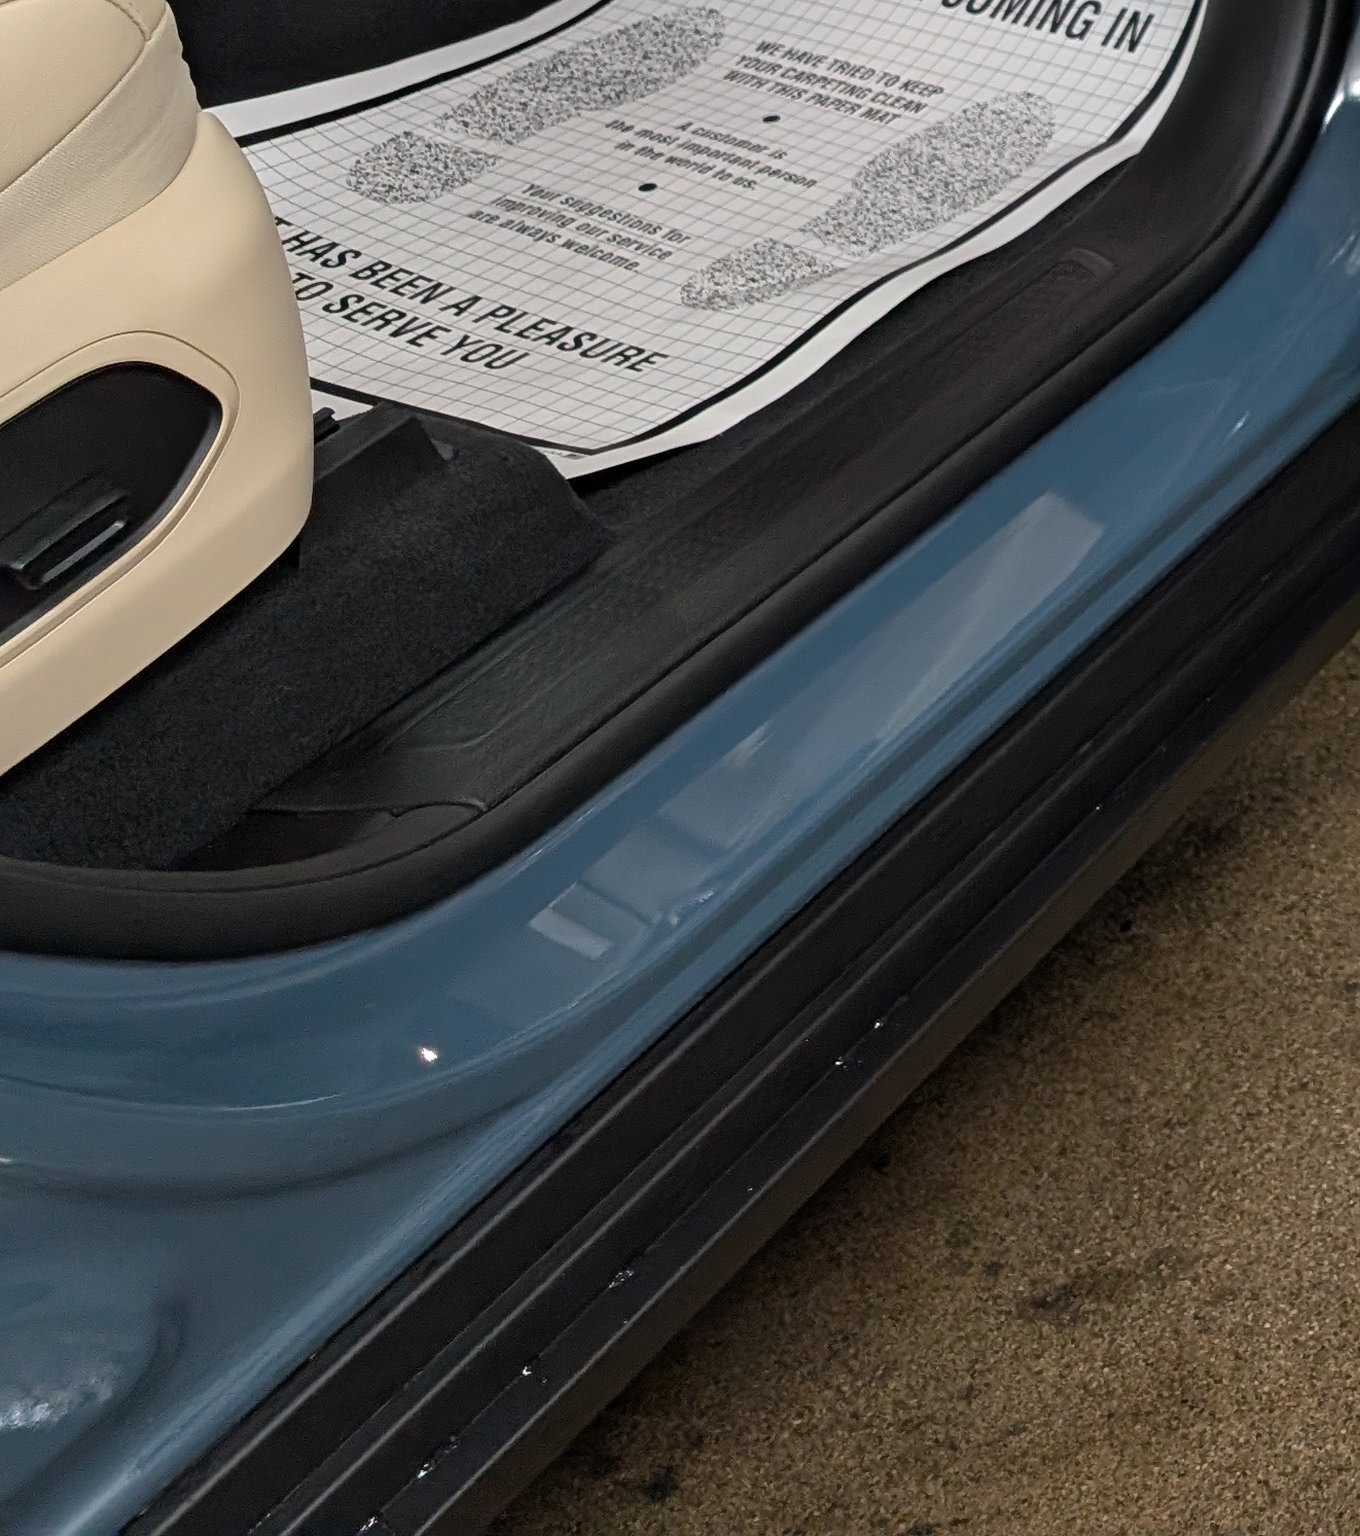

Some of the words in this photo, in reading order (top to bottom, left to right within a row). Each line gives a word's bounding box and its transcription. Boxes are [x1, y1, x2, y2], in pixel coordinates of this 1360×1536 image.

[1101, 7, 1155, 53] IN
[723, 70, 769, 89] WITH
[767, 82, 808, 101] THIS
[805, 93, 862, 114] PAPER
[859, 107, 902, 125] MAT
[735, 55, 783, 75] YOUR
[780, 67, 873, 100] CARPETING
[870, 91, 928, 114] CLEAN
[755, 40, 785, 57] WE
[781, 46, 828, 68] HAVE
[826, 58, 876, 81] TRIED
[875, 71, 901, 88] TO
[898, 79, 945, 98] KEEP
[605, 119, 635, 133] the
[634, 128, 680, 146] most
[677, 139, 760, 169] important
[754, 165, 818, 188] person
[614, 139, 635, 152] in
[634, 146, 665, 161] the
[664, 155, 716, 175] world
[711, 168, 733, 182] to
[732, 176, 757, 191] us.
[675, 121, 694, 131] A
[691, 127, 769, 153] customer
[768, 148, 788, 159] is
[467, 210, 501, 224] are
[498, 220, 562, 243] always
[560, 238, 641, 273] welcome.
[490, 195, 577, 229] improving
[575, 221, 609, 238] our
[606, 233, 674, 261] service
[521, 183, 561, 202] Your
[559, 195, 662, 236] suggestions
[661, 227, 692, 244] for
[282, 230, 362, 269] HAS
[348, 260, 457, 304] BEEN
[438, 295, 484, 317] A
[472, 304, 669, 372] PLEASURE
[292, 272, 334, 301] TO
[322, 294, 452, 348] SERVE
[440, 334, 531, 370] YOU
